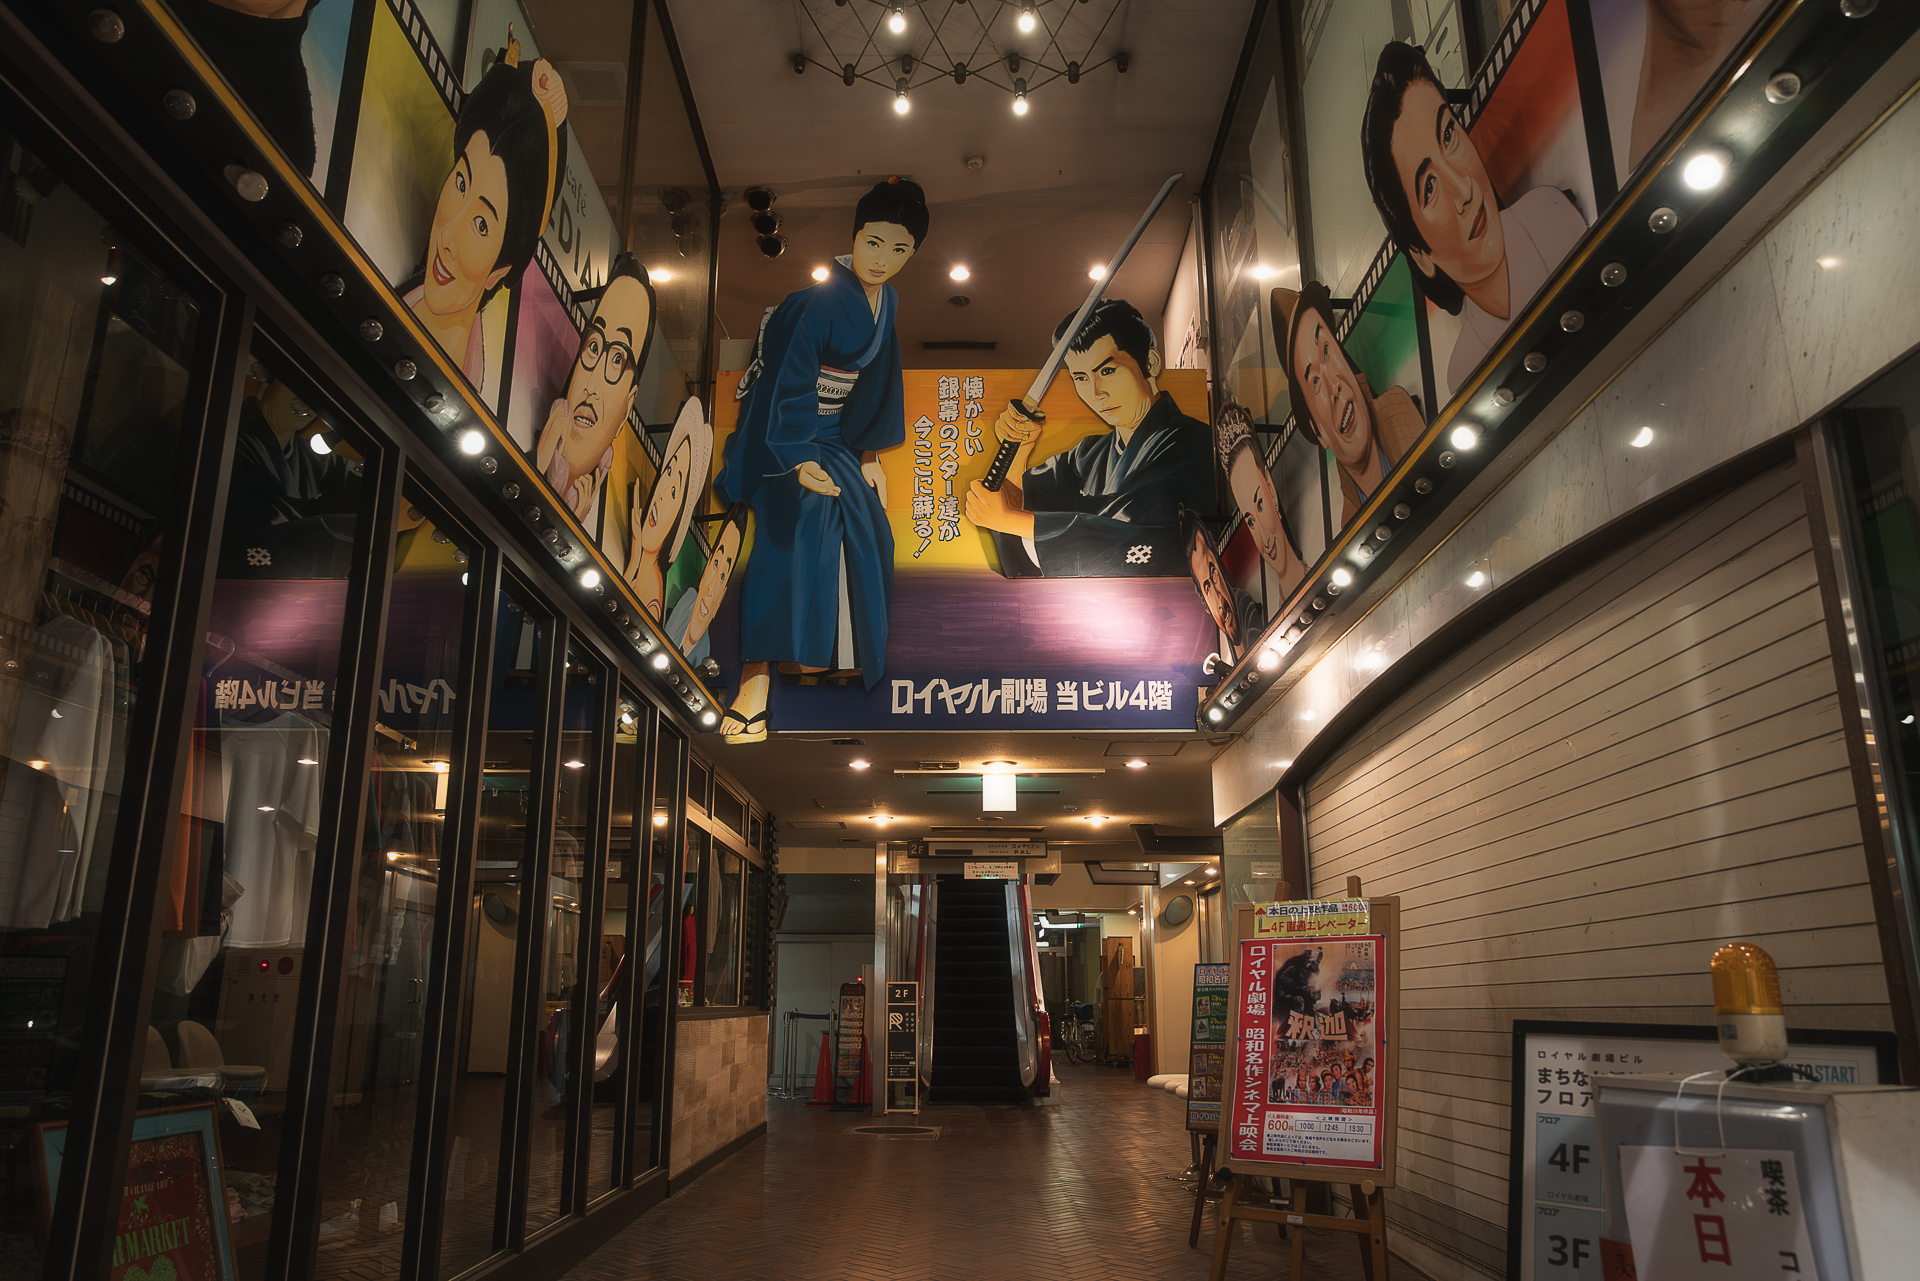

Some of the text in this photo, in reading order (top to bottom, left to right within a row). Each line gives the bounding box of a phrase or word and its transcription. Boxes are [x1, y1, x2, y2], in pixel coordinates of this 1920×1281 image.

[962, 376, 985, 456] 懐かしい
[937, 375, 961, 541] 銀幕のスター達が
[912, 414, 936, 559] 今ここに蘇る！
[891, 678, 1173, 714] ロイヤル劇場 当ビル4階
[910, 844, 925, 854] 2F
[1269, 903, 1338, 916] 本日の上映作品
[1271, 918, 1368, 932] 4F直通エレベーター
[895, 989, 909, 998] 2F
[1285, 1009, 1348, 1041] 釈迦
[1238, 946, 1266, 1151] ロイヤル劇場・昭和名作シネマ上映会
[1538, 1051, 1643, 1063] ロイヤル劇場ビル
[1815, 1065, 1857, 1083] START
[1268, 1120, 1294, 1132] 600円
[1300, 1122, 1315, 1130] 10:00
[1324, 1123, 1339, 1131] 12:45
[1538, 1115, 1560, 1125] フロア
[1349, 1125, 1364, 1133] 15:30
[1548, 1143, 1590, 1174] 4F
[1760, 1159, 1790, 1216] 喫茶
[1547, 1191, 1589, 1203] ロイヤル劇場
[1537, 1207, 1559, 1217] フロア
[1683, 1158, 1732, 1266] 本日
[1547, 1234, 1590, 1269] 3F
